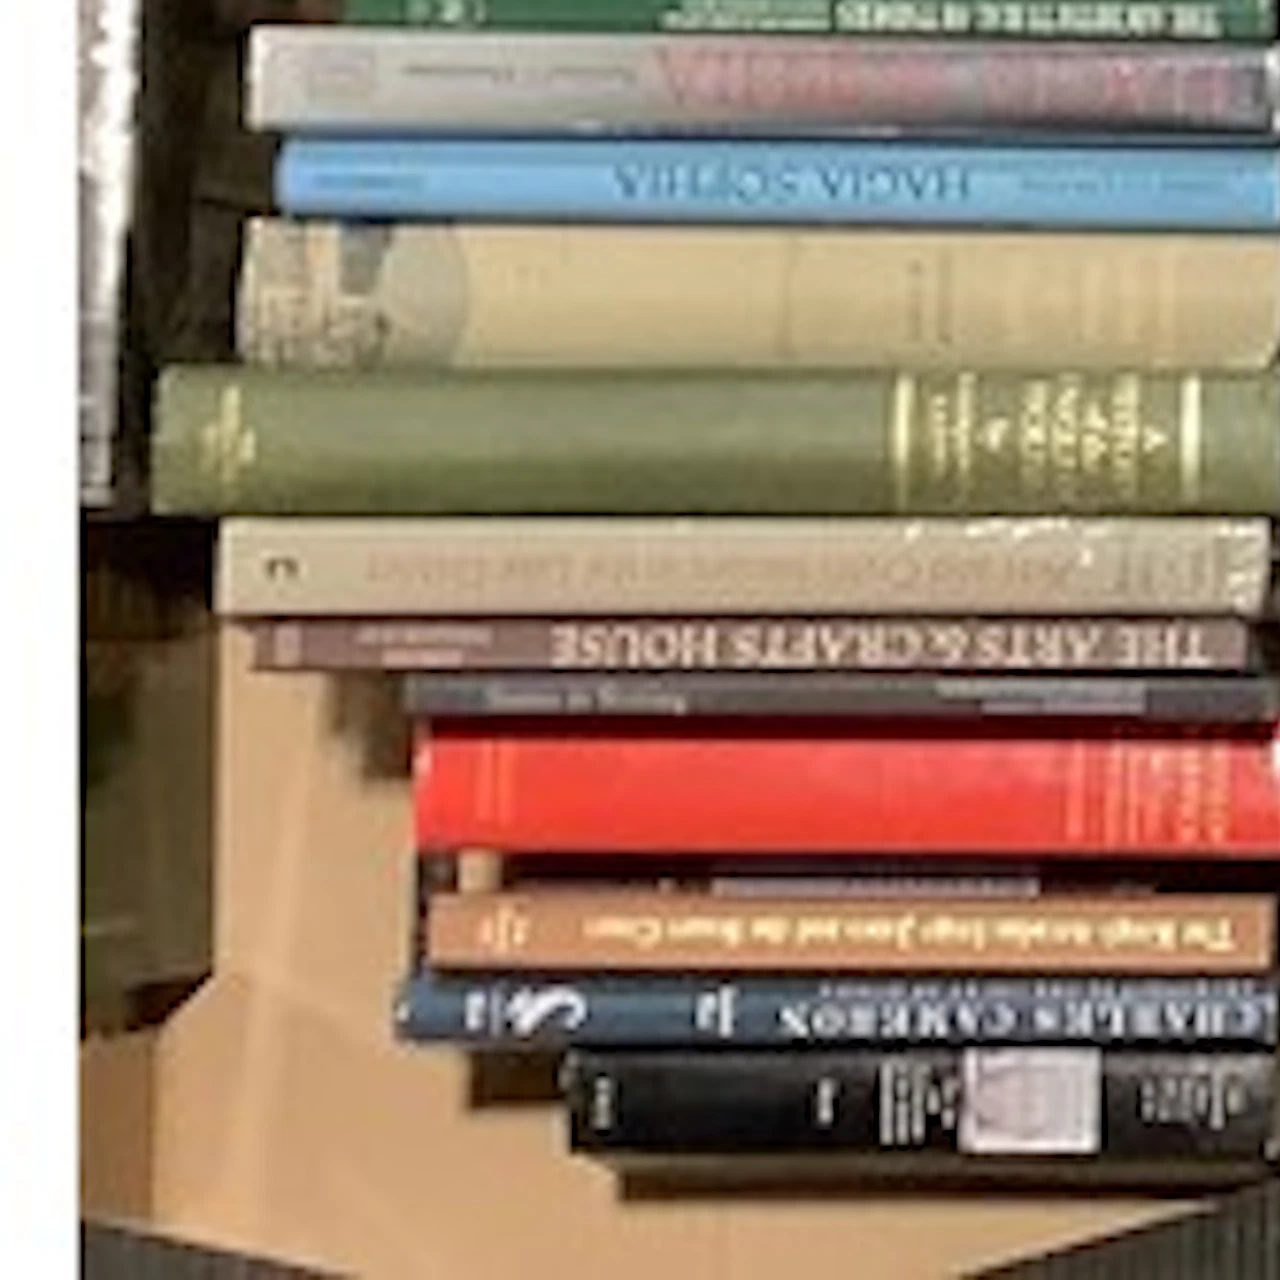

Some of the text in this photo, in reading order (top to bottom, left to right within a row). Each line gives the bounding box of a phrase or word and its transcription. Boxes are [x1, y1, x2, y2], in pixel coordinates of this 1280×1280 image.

[612, 164, 971, 204] HAGIA SOPHIA
[550, 624, 1213, 668] THE ARTS & CRAFTS HOUSE
[776, 1000, 1260, 1040] CHARLES CAMERON
